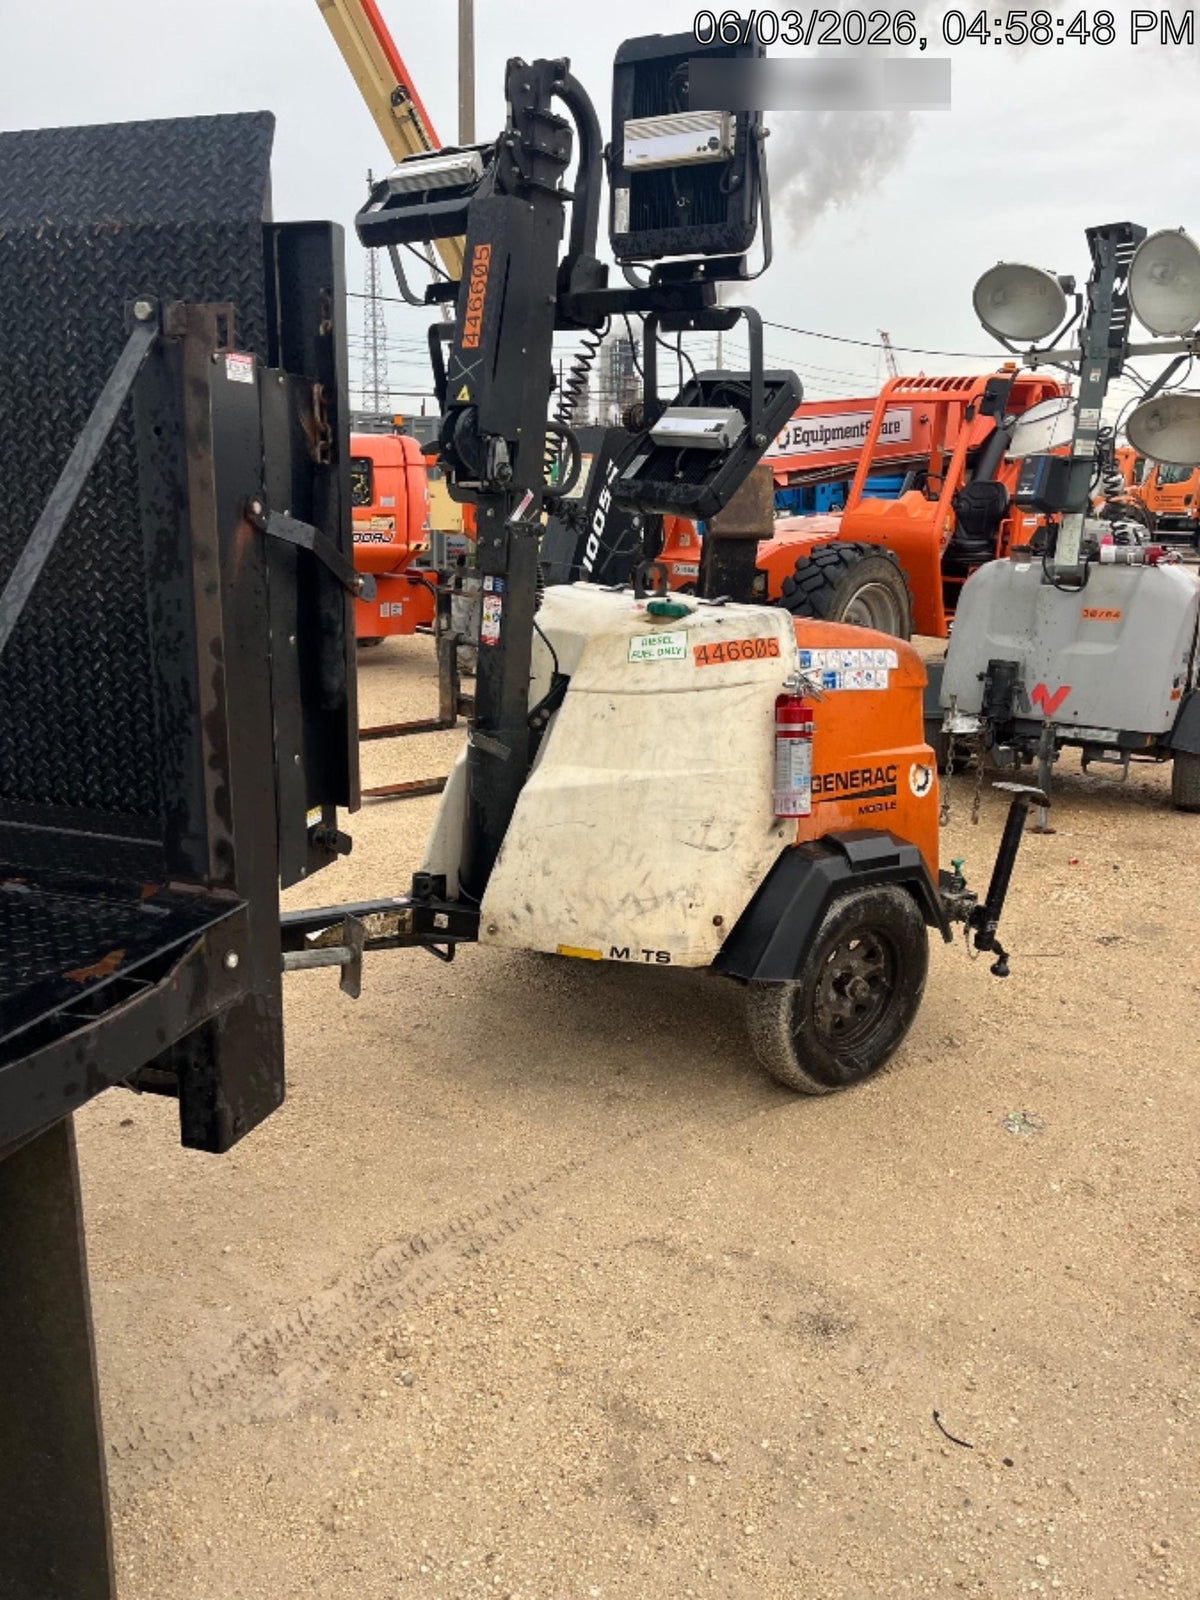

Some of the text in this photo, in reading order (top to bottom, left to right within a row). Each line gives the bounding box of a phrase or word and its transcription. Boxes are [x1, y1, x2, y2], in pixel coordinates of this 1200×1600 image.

[463, 246, 490, 346] 446605
[793, 420, 901, 447] EquipmentSare
[641, 636, 674, 647] DIESEL
[657, 646, 682, 656] ONLY
[696, 638, 779, 664] 446605
[811, 764, 898, 794] GENERAC
